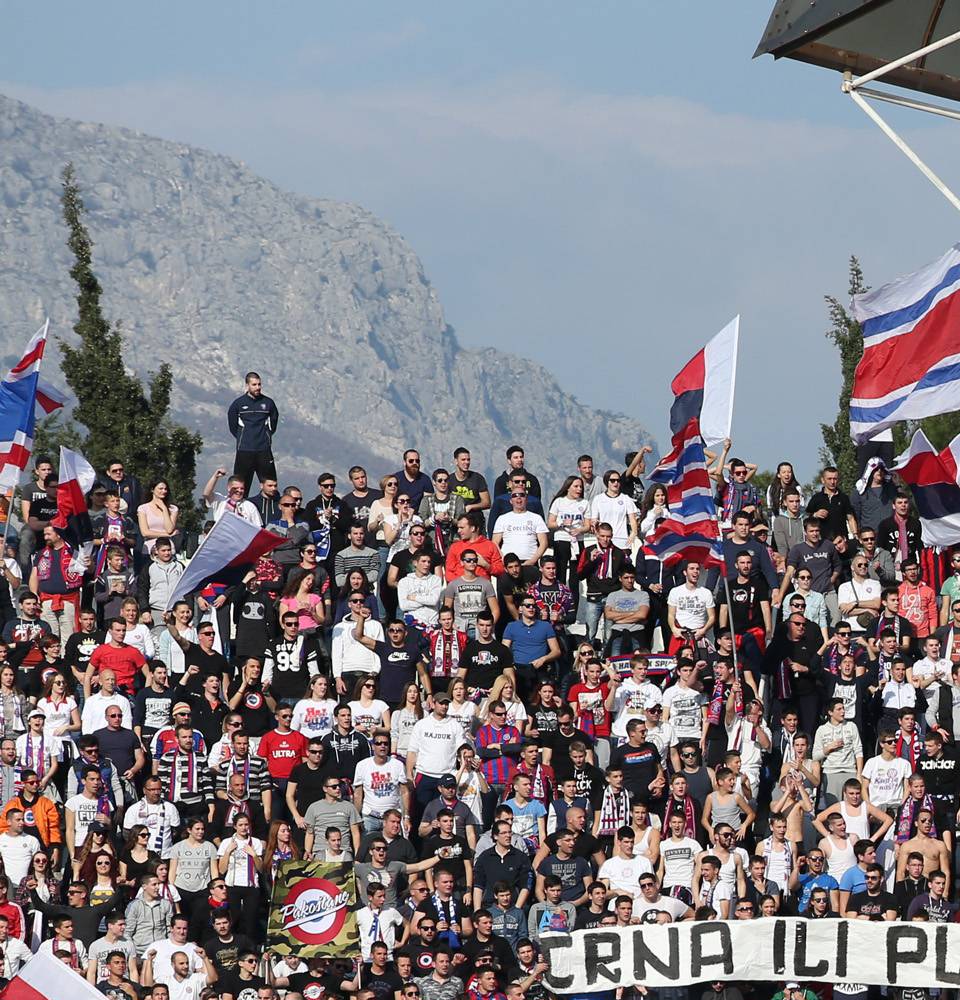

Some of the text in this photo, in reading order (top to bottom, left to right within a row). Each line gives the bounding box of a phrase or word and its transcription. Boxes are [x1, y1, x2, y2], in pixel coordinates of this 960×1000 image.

[424, 731, 452, 740] HAJDUK
[272, 750, 296, 758] ULTRA
[920, 760, 956, 770] adidas
[541, 920, 734, 988] CRNA
[773, 919, 848, 977] ILI
